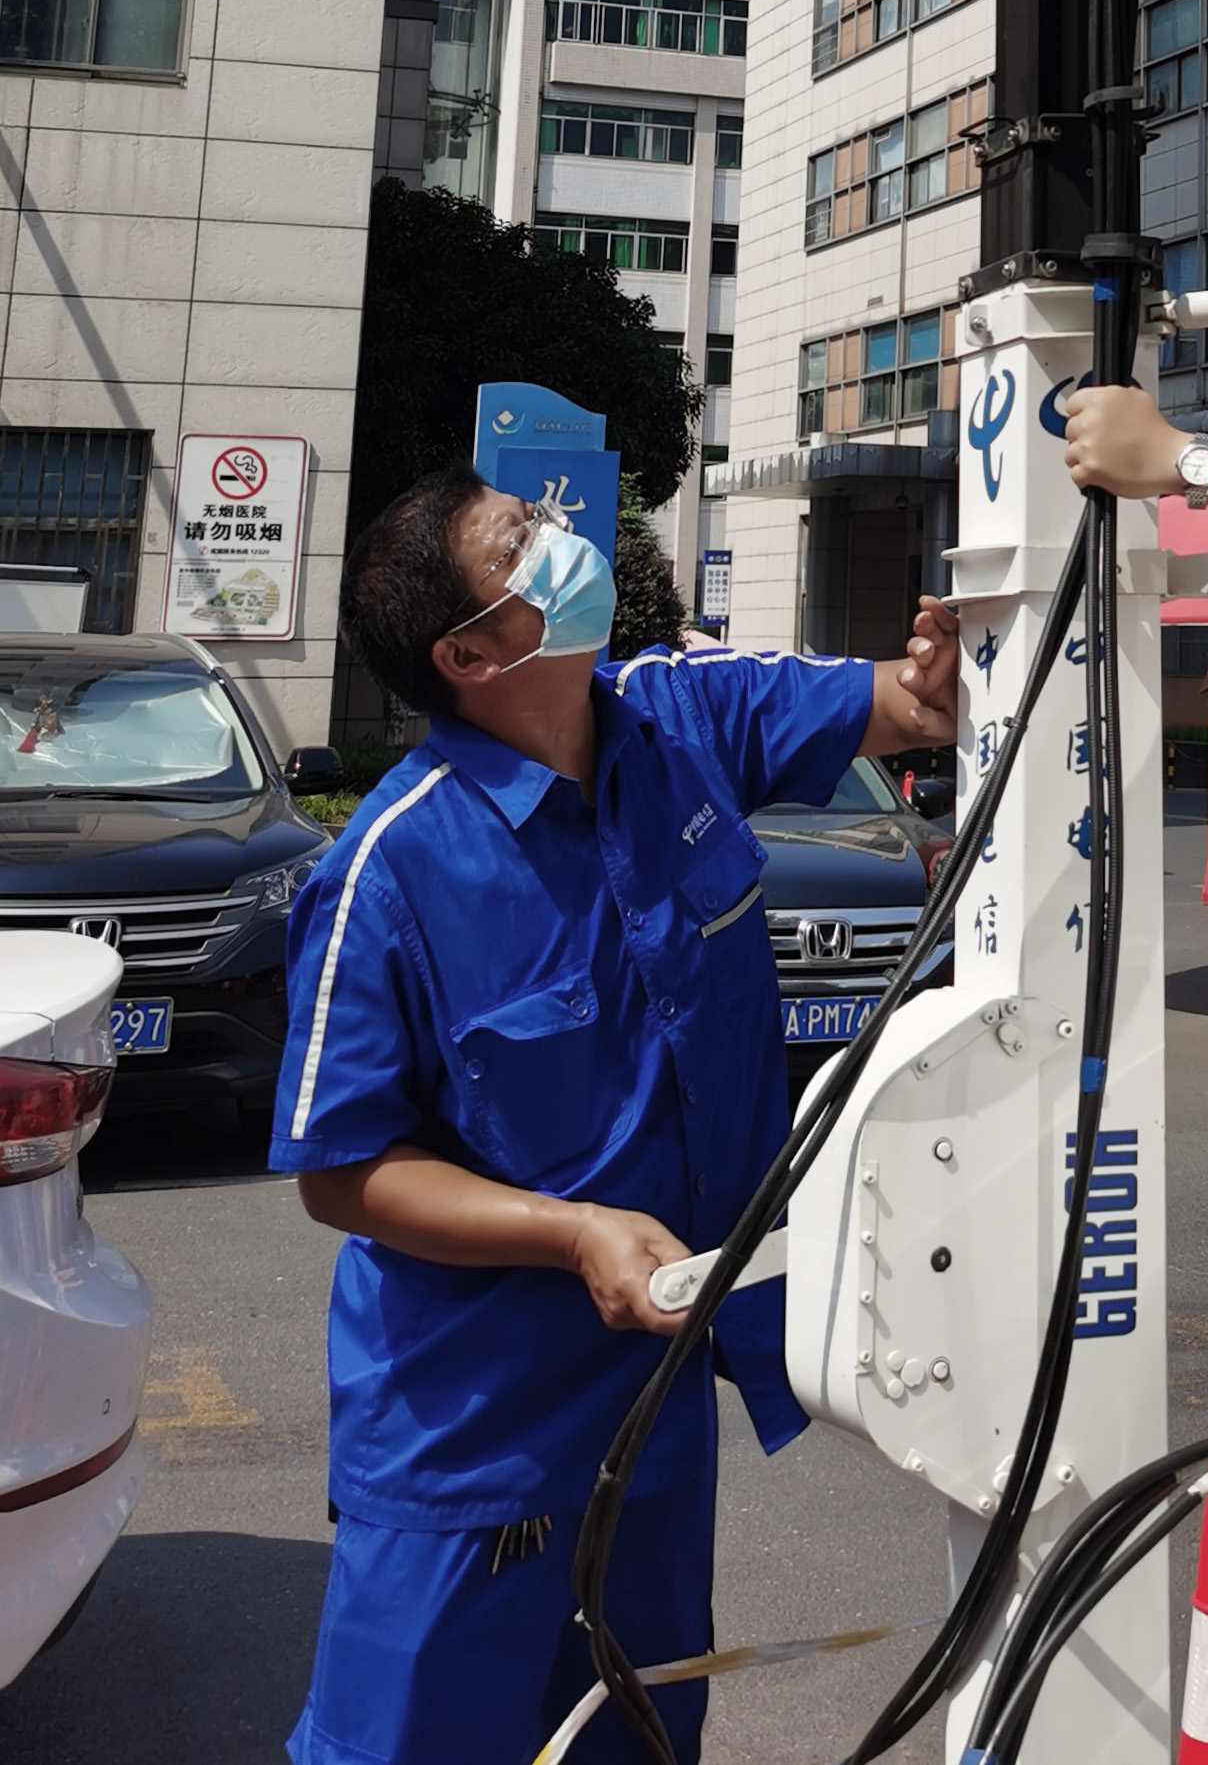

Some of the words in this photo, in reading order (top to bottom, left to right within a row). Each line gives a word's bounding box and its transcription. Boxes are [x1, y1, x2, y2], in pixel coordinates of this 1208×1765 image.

[203, 504, 267, 519] 无烟医院
[184, 521, 283, 542] 请勿吸烟
